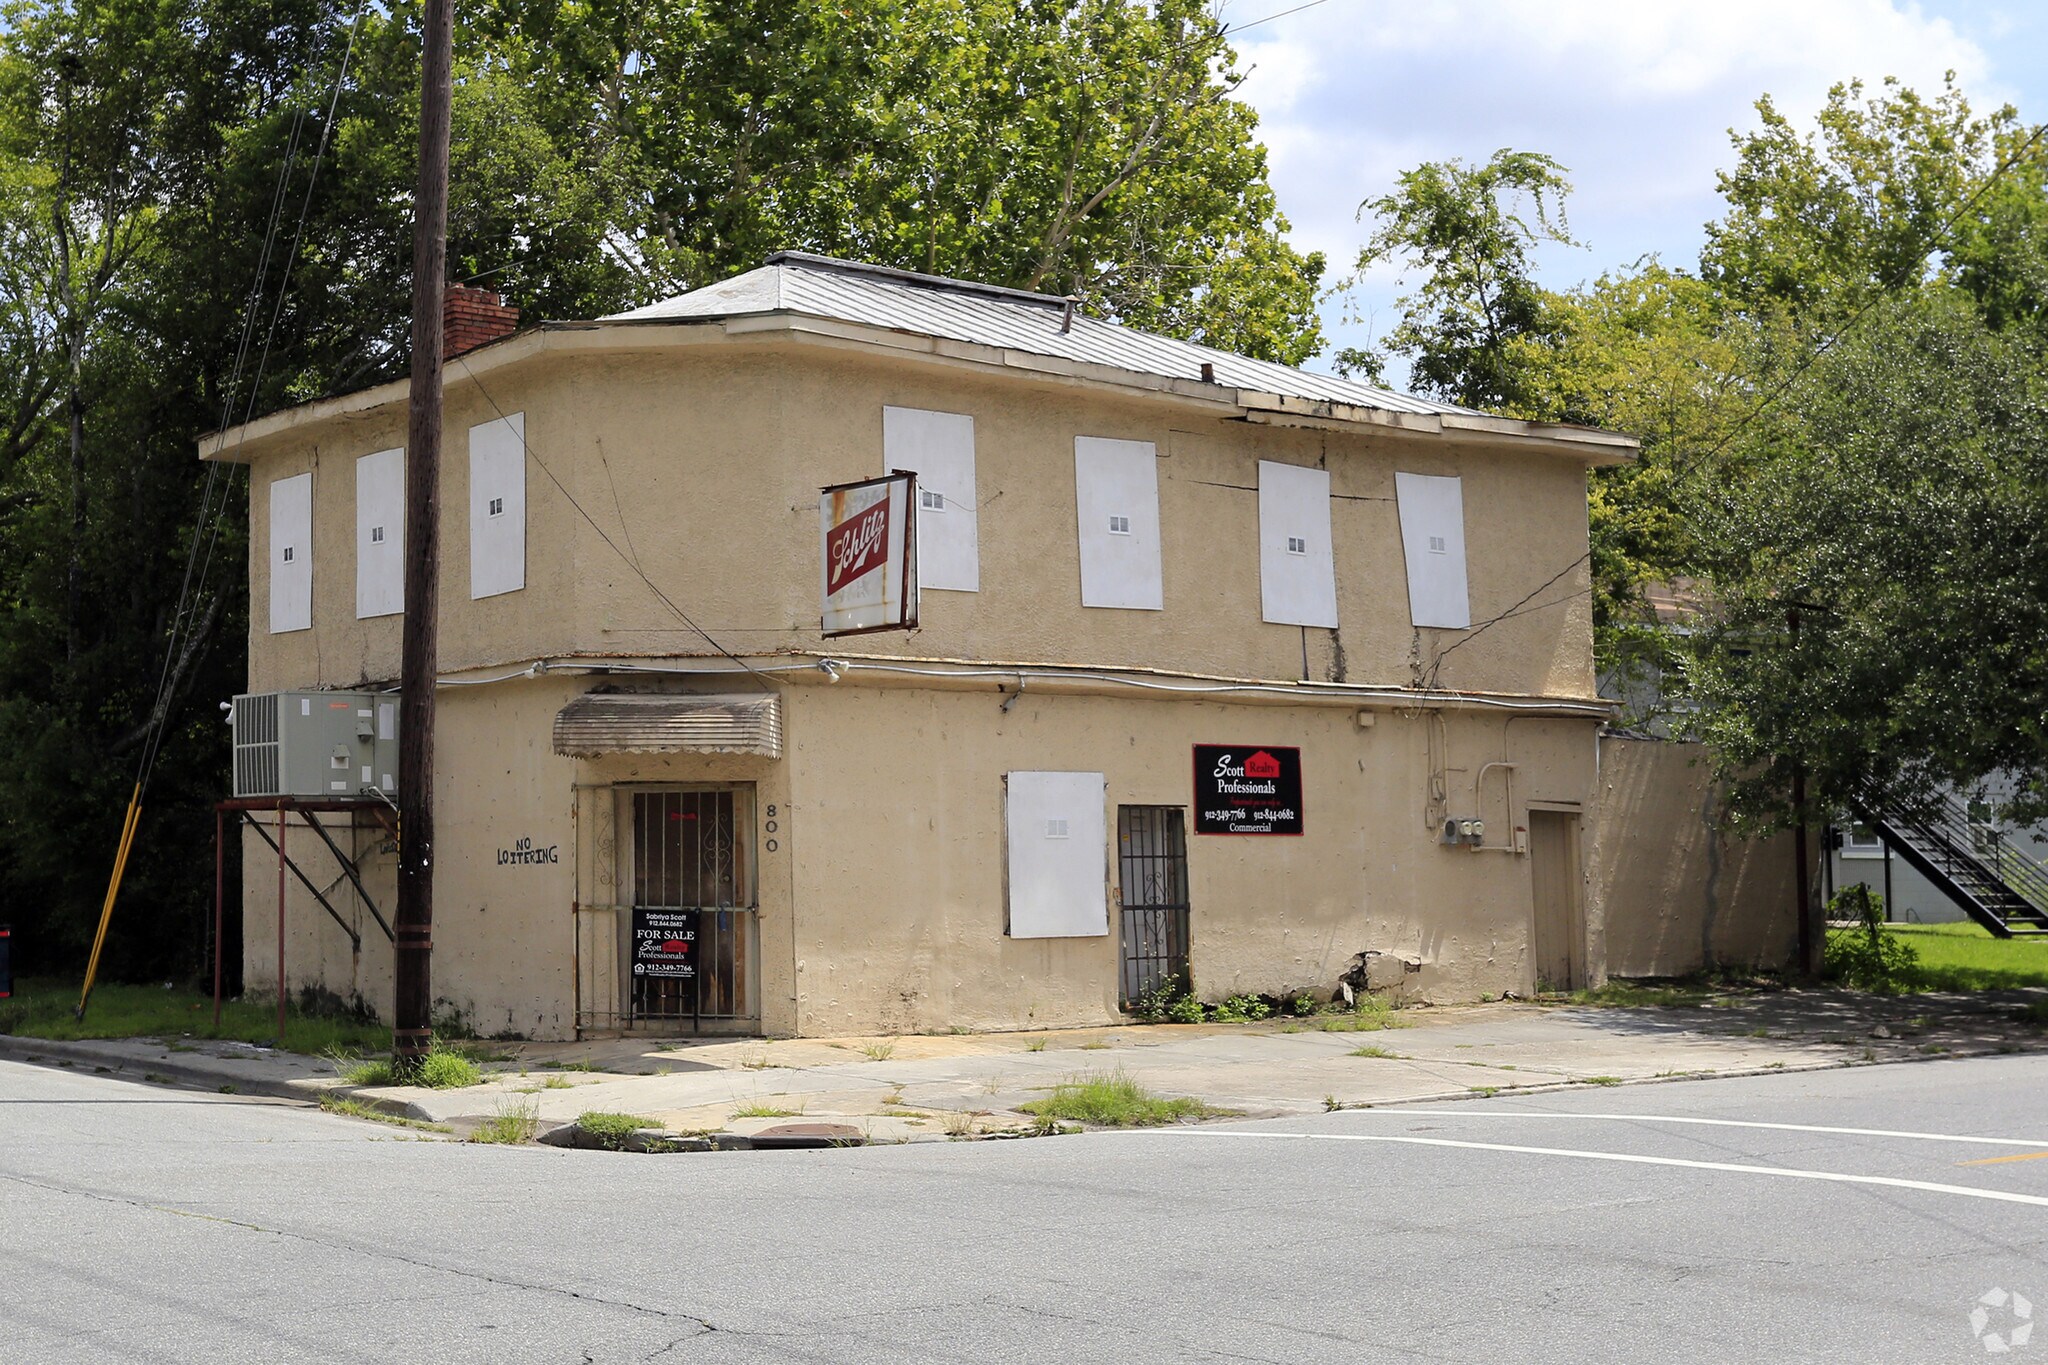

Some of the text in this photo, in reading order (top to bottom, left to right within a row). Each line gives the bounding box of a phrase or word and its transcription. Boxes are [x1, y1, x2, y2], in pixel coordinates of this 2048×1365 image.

[831, 509, 885, 585] Schlitz
[1213, 754, 1276, 777] Scott Realty
[1217, 779, 1276, 794] Professionals
[1204, 808, 1295, 821] 912-349-7766 912-844-0682
[1229, 822, 1272, 832] Commercial
[516, 837, 531, 851] NO
[497, 845, 558, 865] LOITERING
[637, 930, 695, 940] FOR SALE
[639, 940, 662, 951] Scott
[638, 951, 684, 959] Professionals
